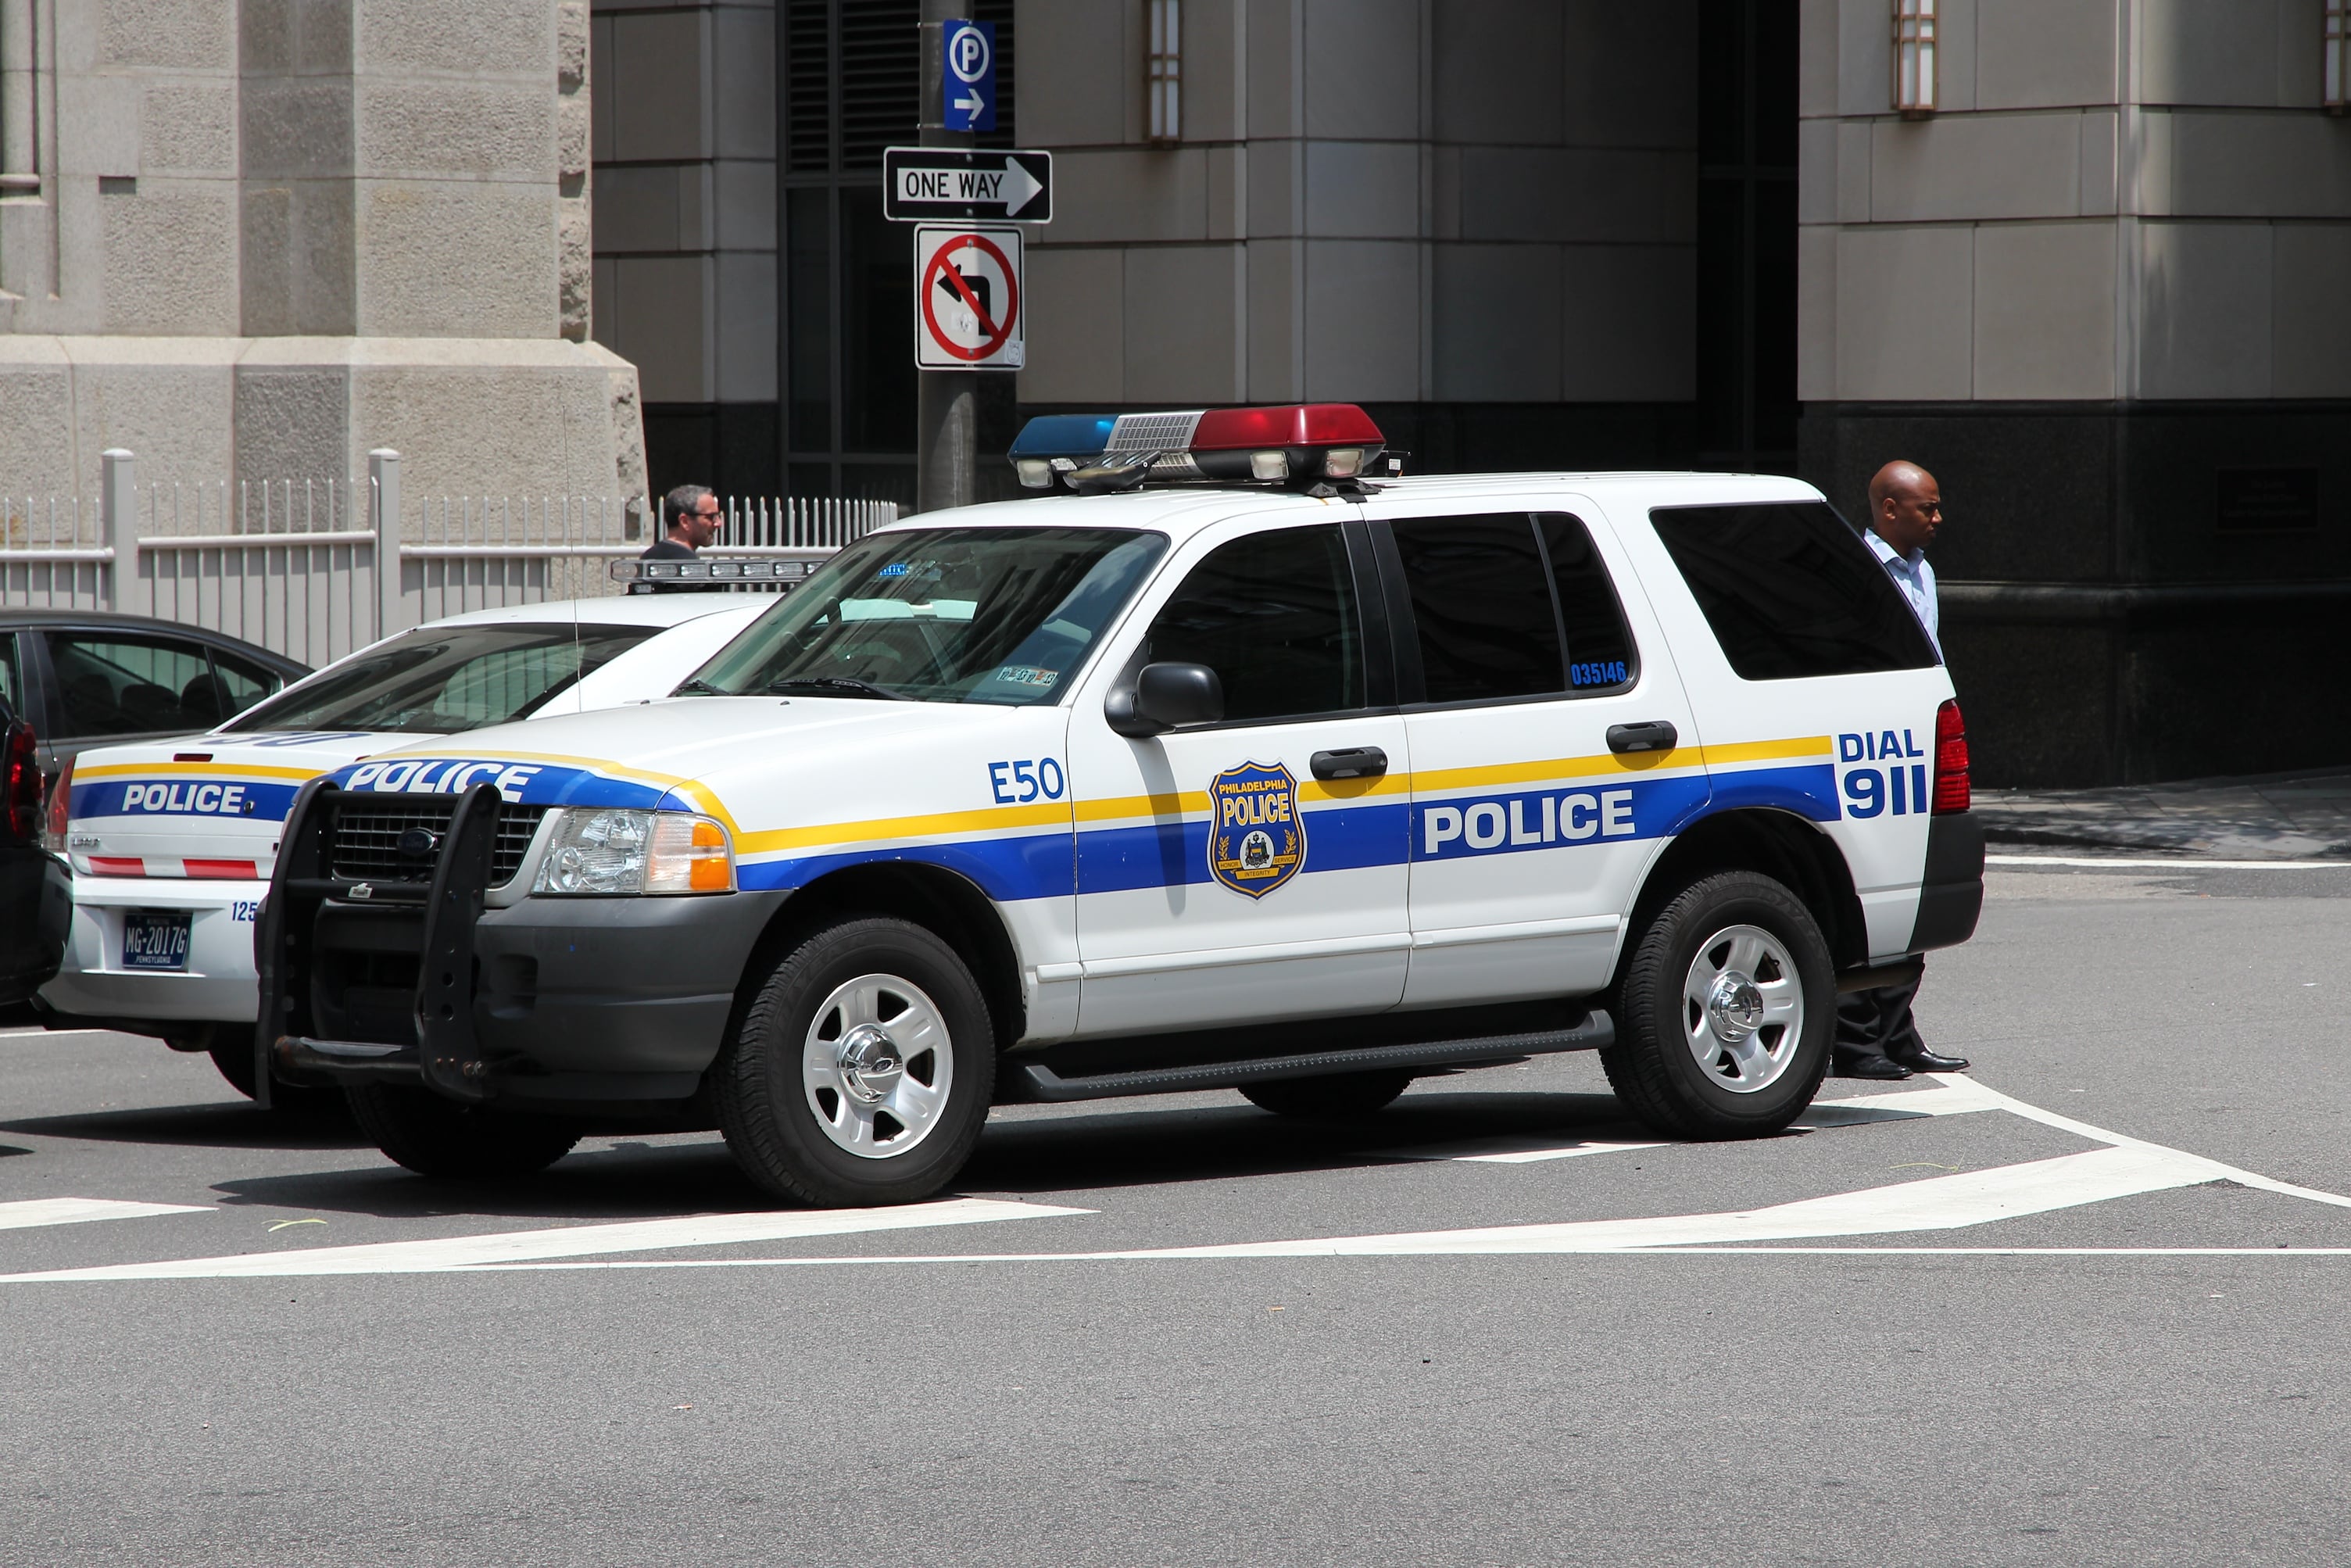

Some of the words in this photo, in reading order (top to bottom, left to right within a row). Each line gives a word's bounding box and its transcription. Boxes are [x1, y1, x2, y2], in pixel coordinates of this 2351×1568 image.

[962, 38, 979, 72] P
[906, 172, 950, 198] ONE
[959, 173, 1004, 199] WAY
[1570, 661, 1626, 686] 035146
[1838, 729, 1924, 763] DIAL
[344, 761, 542, 804] POLICE
[988, 757, 1064, 804] E50
[1218, 779, 1288, 795] PHILADELPHIA
[1844, 764, 1927, 819] 911
[121, 784, 245, 814] POLICE
[1222, 793, 1290, 828] POLICE
[1424, 789, 1636, 854] POLICE
[232, 901, 258, 922] 125
